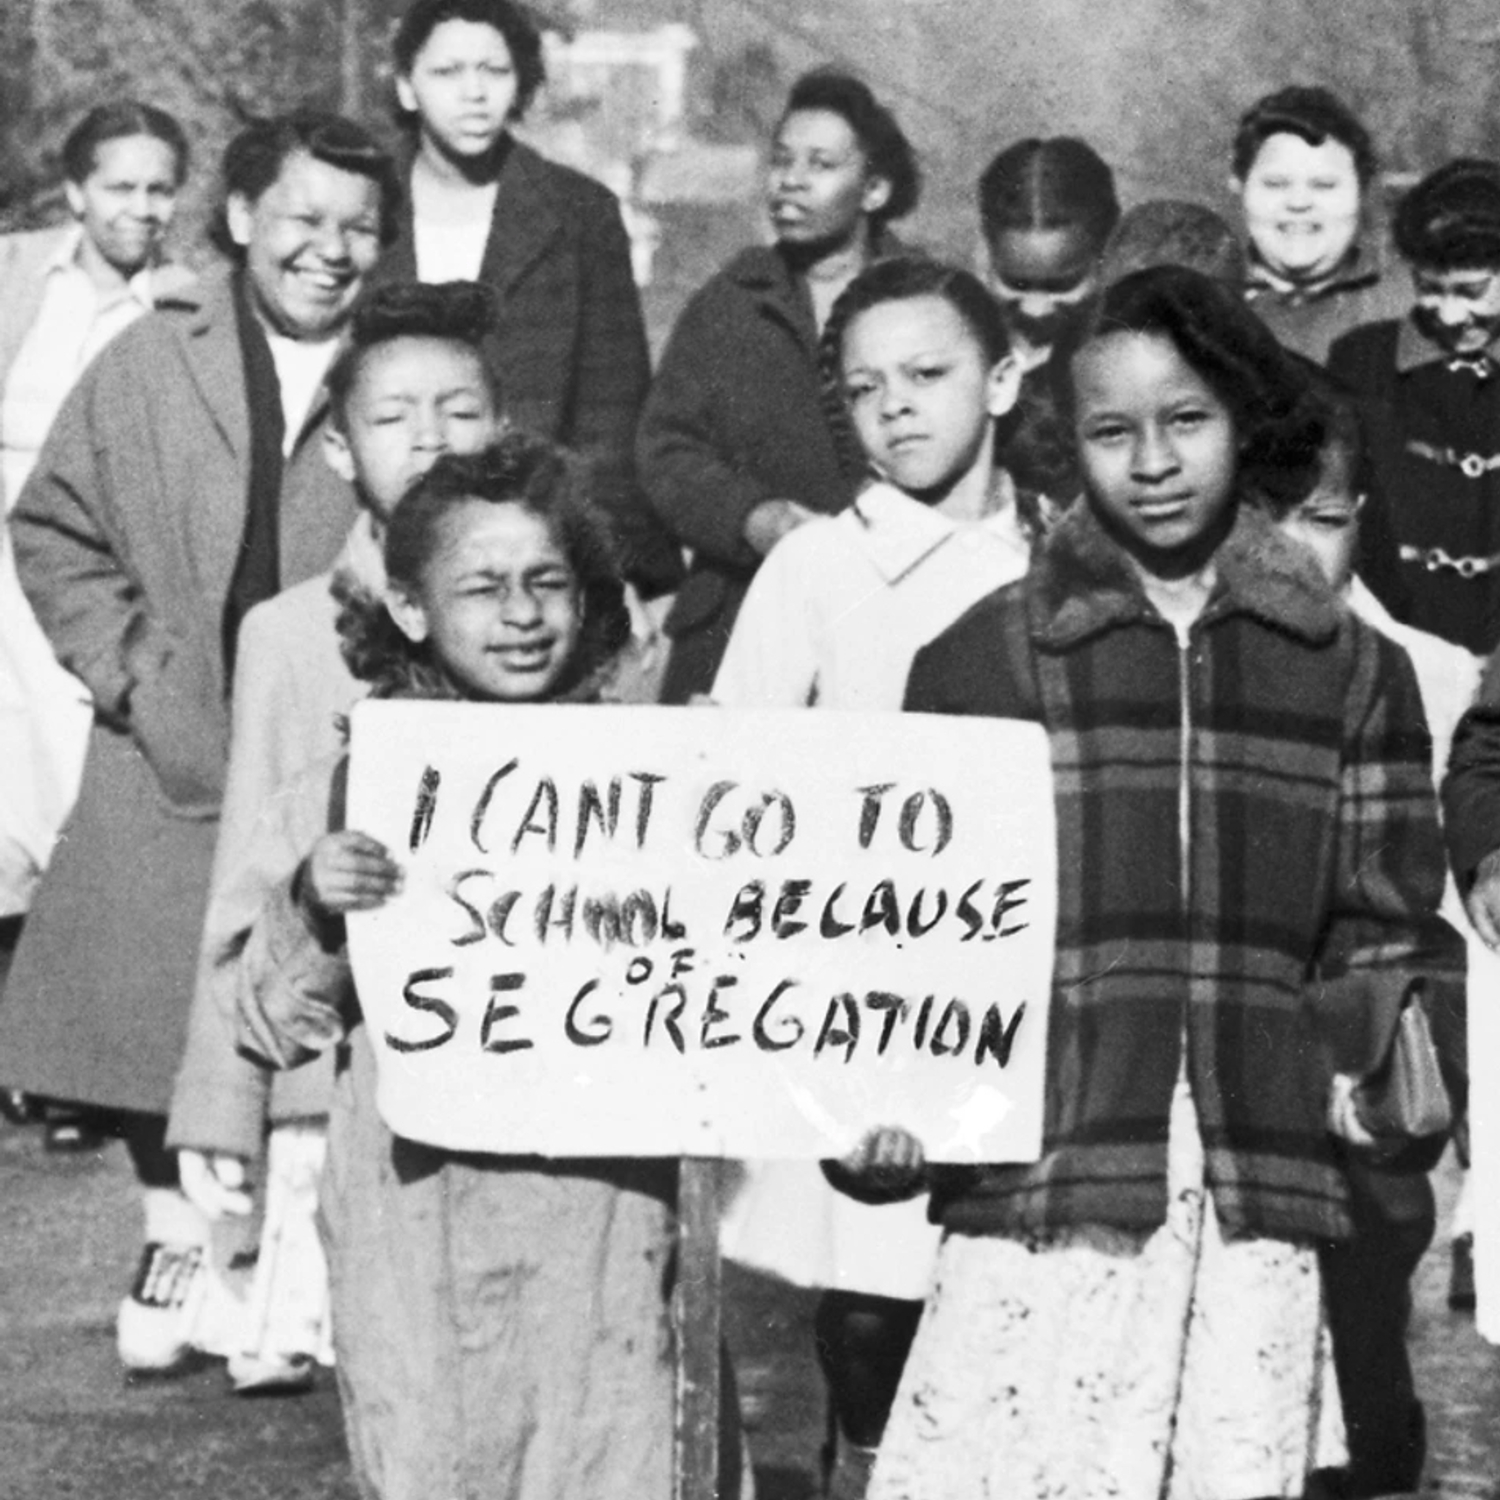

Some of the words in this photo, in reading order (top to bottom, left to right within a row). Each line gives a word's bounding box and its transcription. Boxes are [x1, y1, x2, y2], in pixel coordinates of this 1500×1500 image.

[409, 766, 440, 853] I
[470, 757, 666, 859] CANT
[694, 780, 795, 860] GO
[856, 783, 952, 857] TO
[450, 869, 686, 947] SCHOOL
[723, 878, 1031, 942] BECAUSE
[626, 948, 696, 986] OF
[385, 966, 1026, 1068] SEGREGATION
